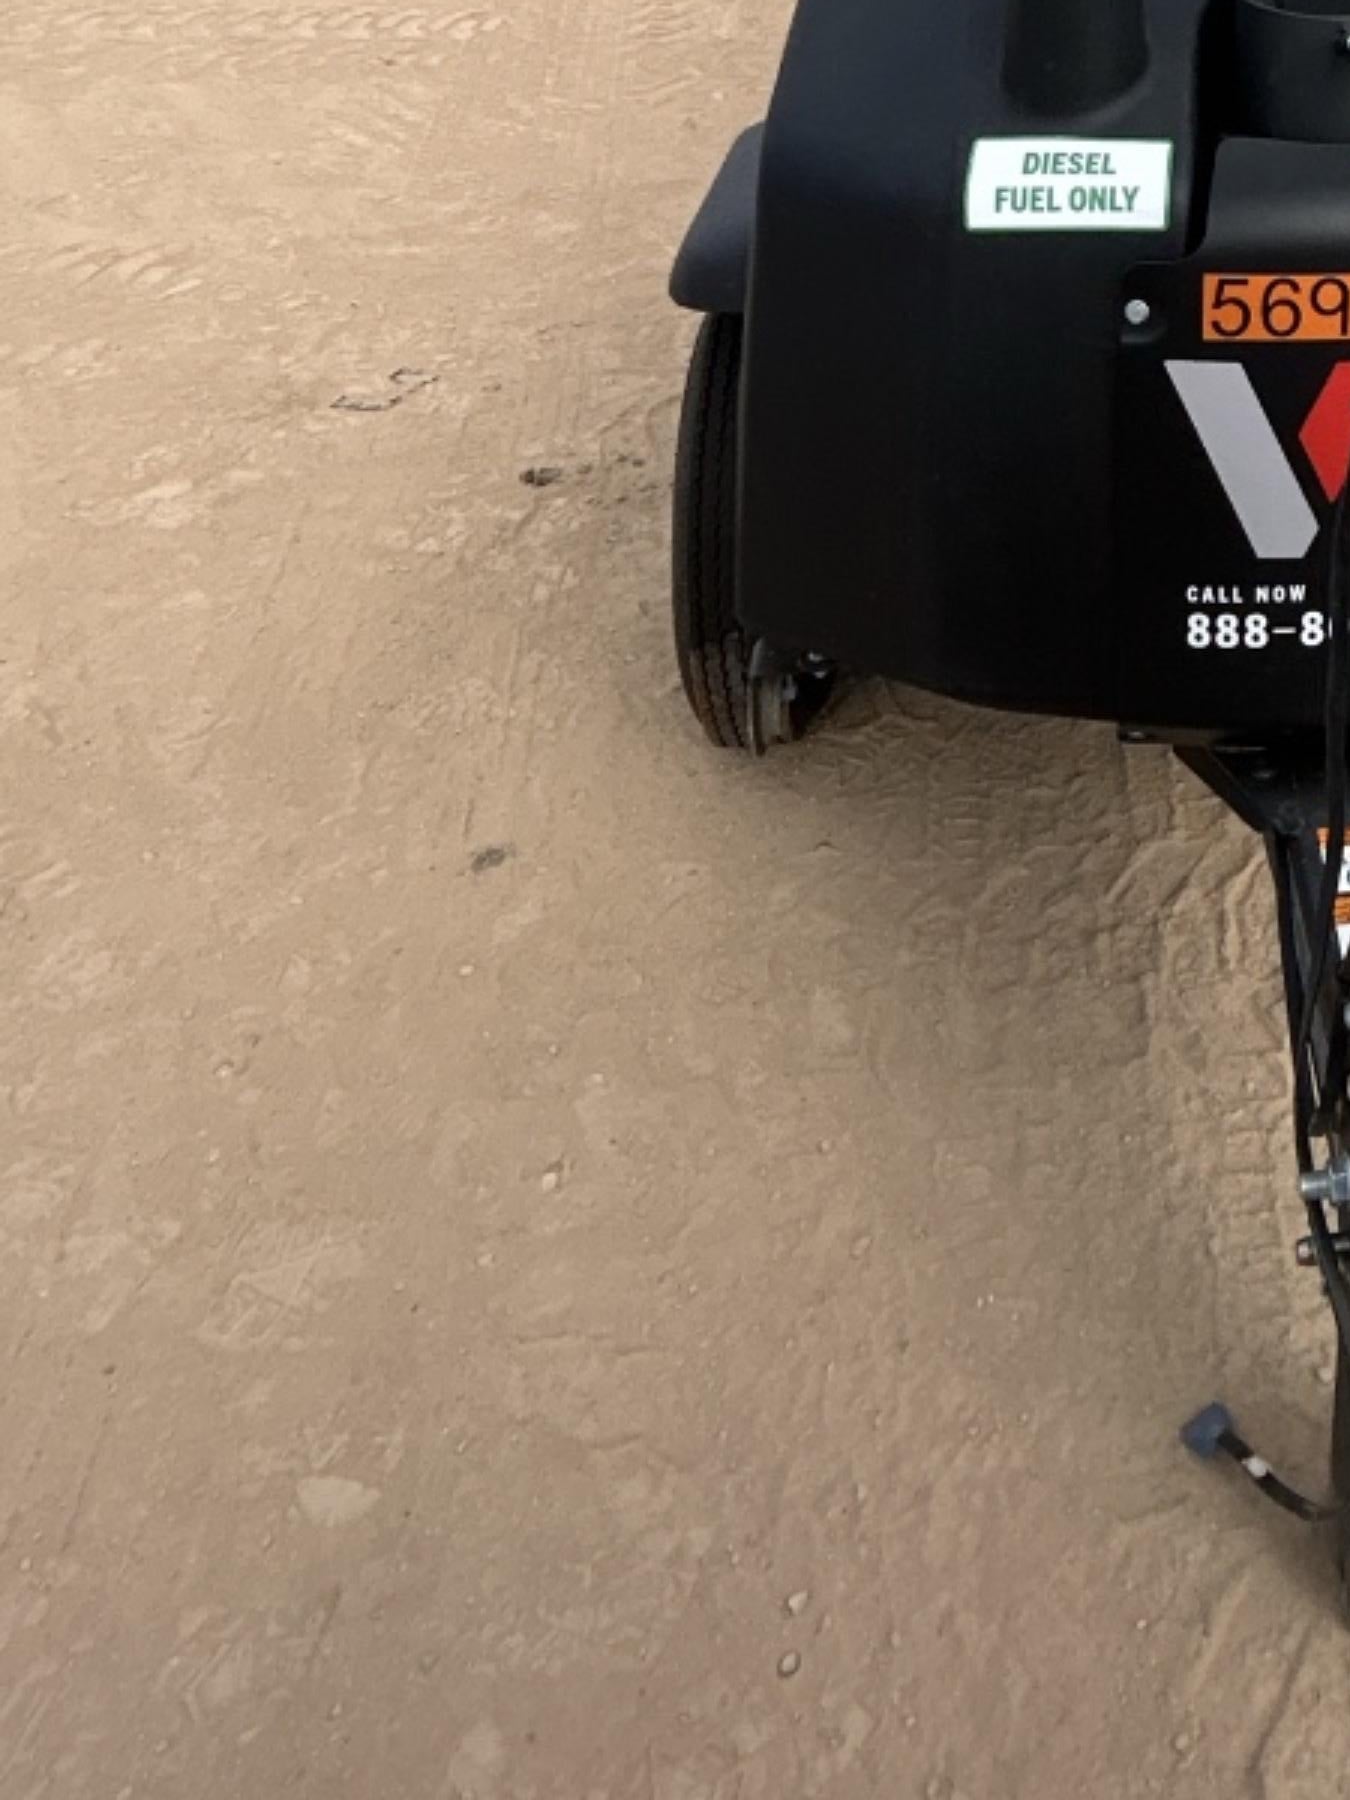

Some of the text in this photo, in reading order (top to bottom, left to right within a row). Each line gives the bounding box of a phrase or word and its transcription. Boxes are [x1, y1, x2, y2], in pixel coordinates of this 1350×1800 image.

[1022, 152, 1116, 176] DIESEL
[995, 185, 1140, 213] FUEL ONLY
[1186, 584, 1307, 604] CALL NOW
